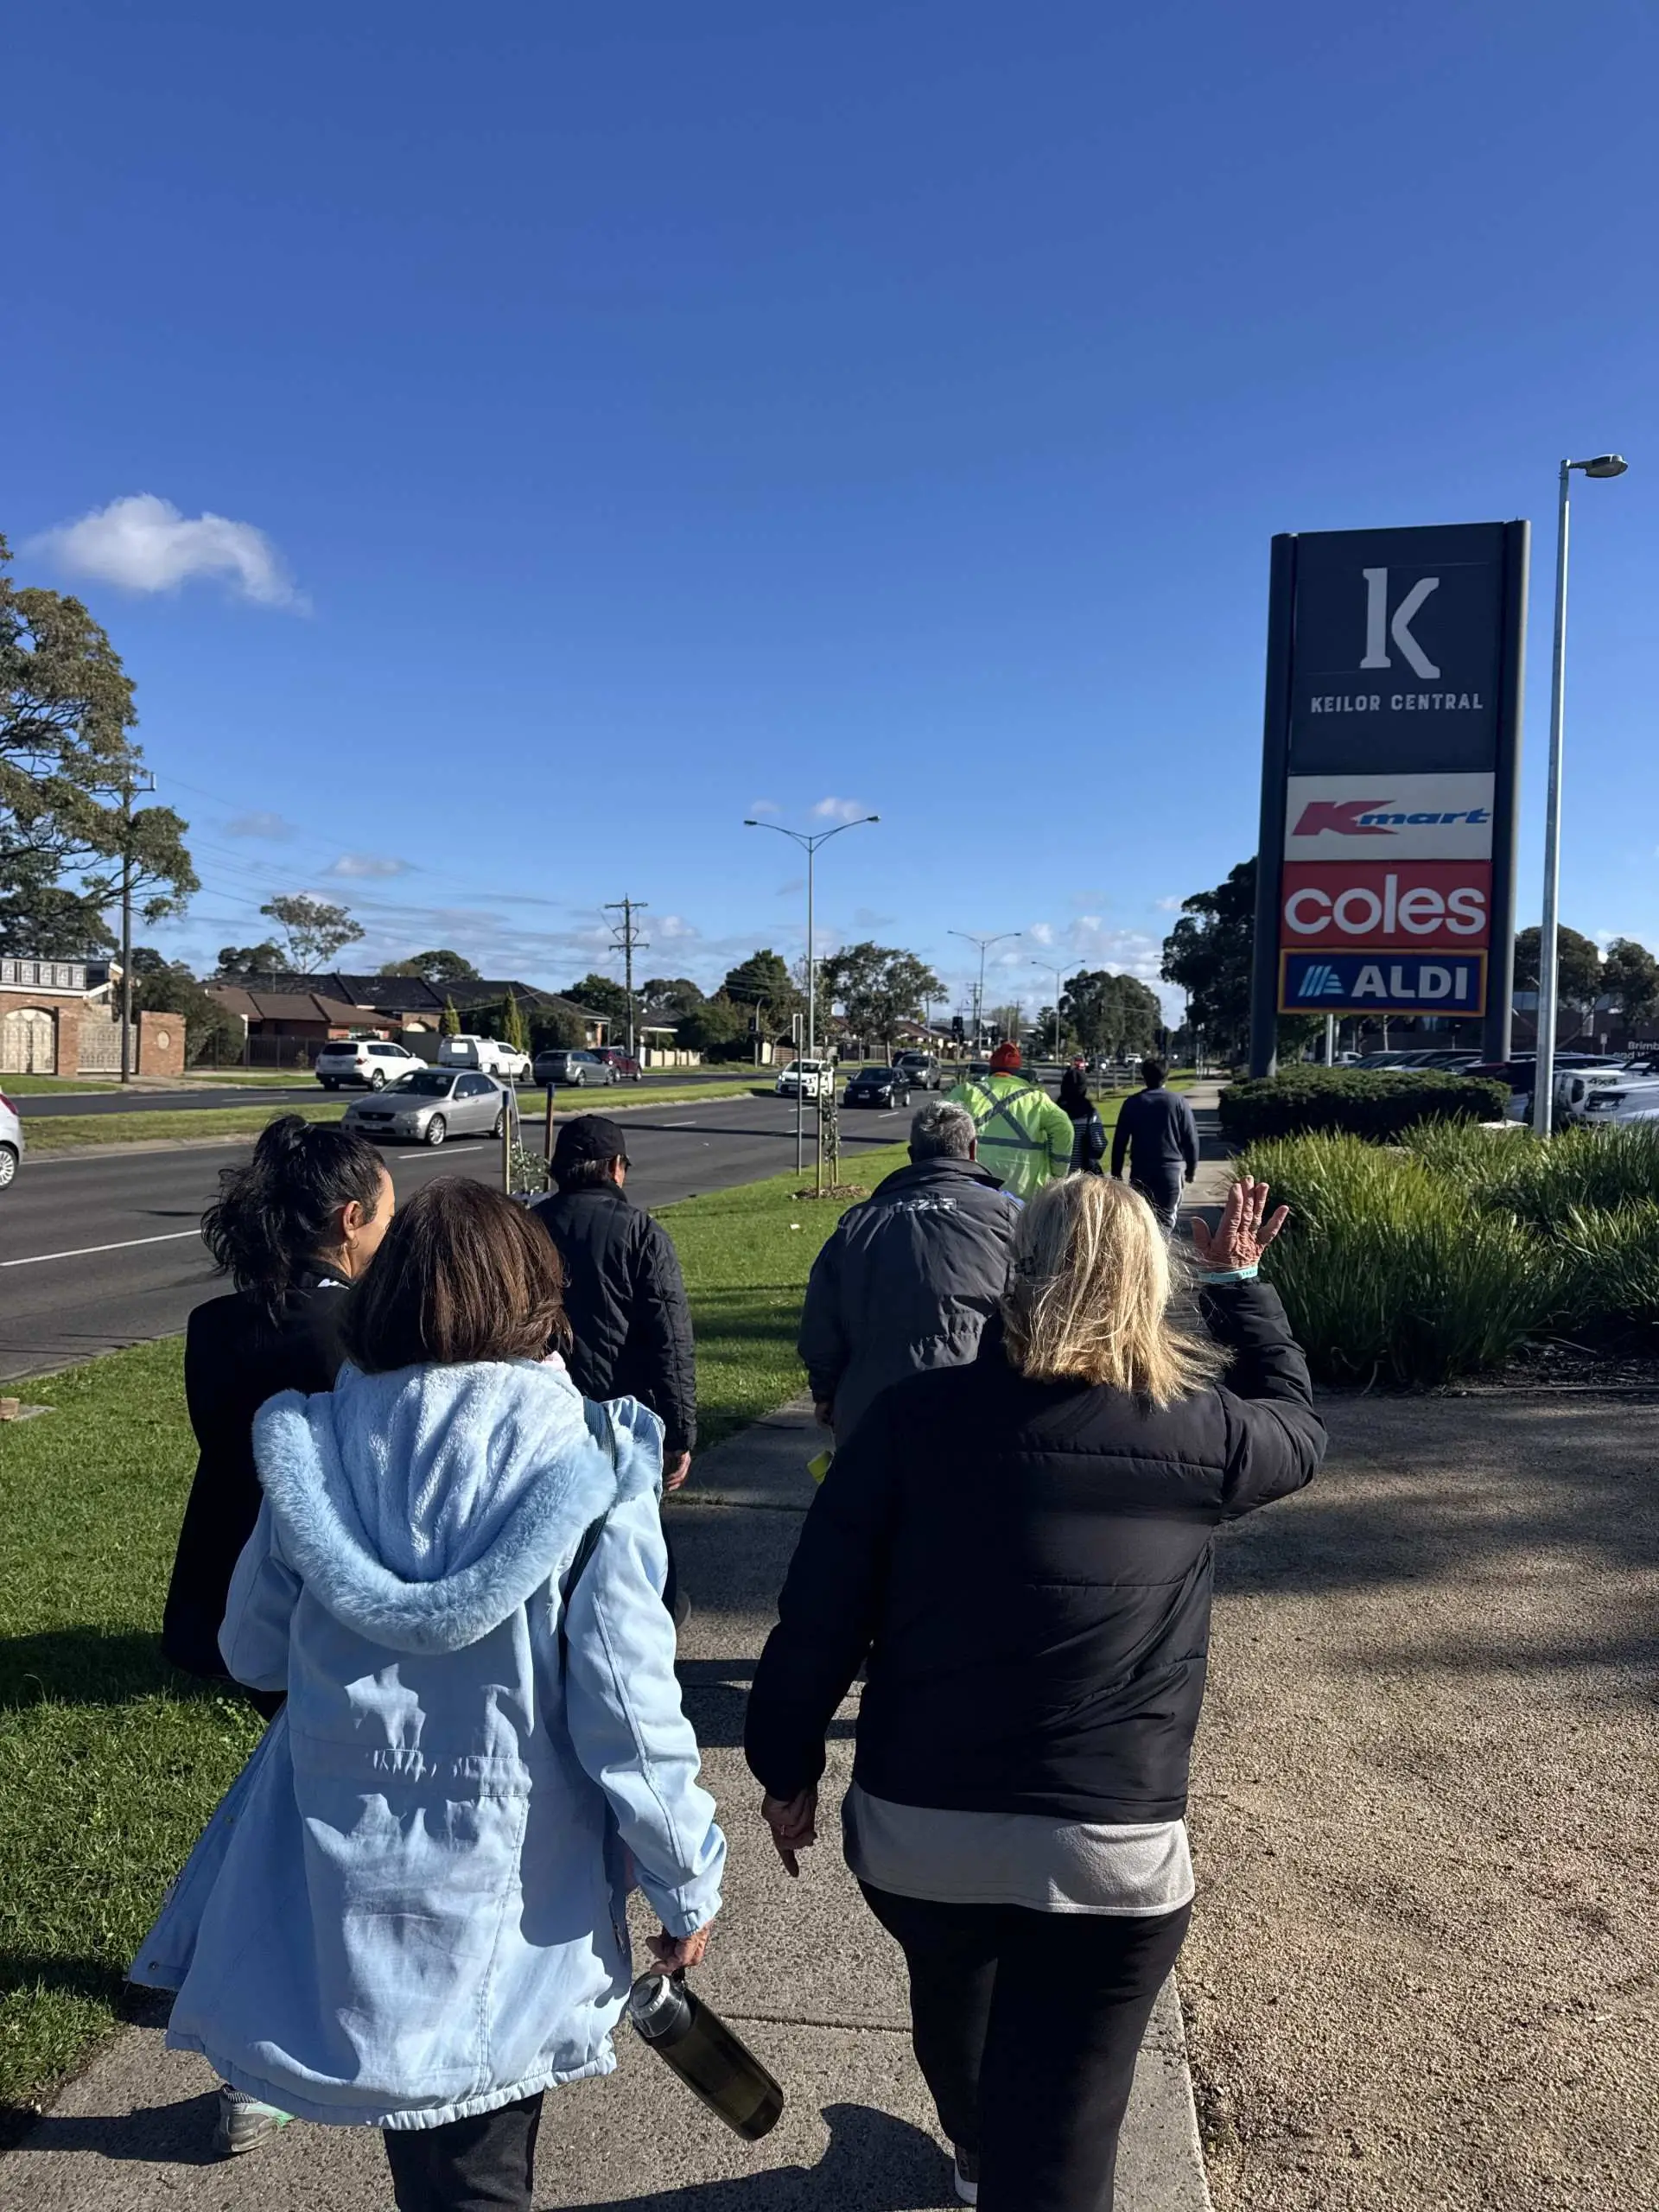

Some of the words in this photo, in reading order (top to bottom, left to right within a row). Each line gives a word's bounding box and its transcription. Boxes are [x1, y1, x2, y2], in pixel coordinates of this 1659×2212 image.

[1311, 695, 1381, 713] KEILOR
[1391, 693, 1484, 710] CENTRAL
[1291, 799, 1491, 836] Kmart
[1284, 874, 1487, 935] coles
[1351, 965, 1468, 1000] ALDI
